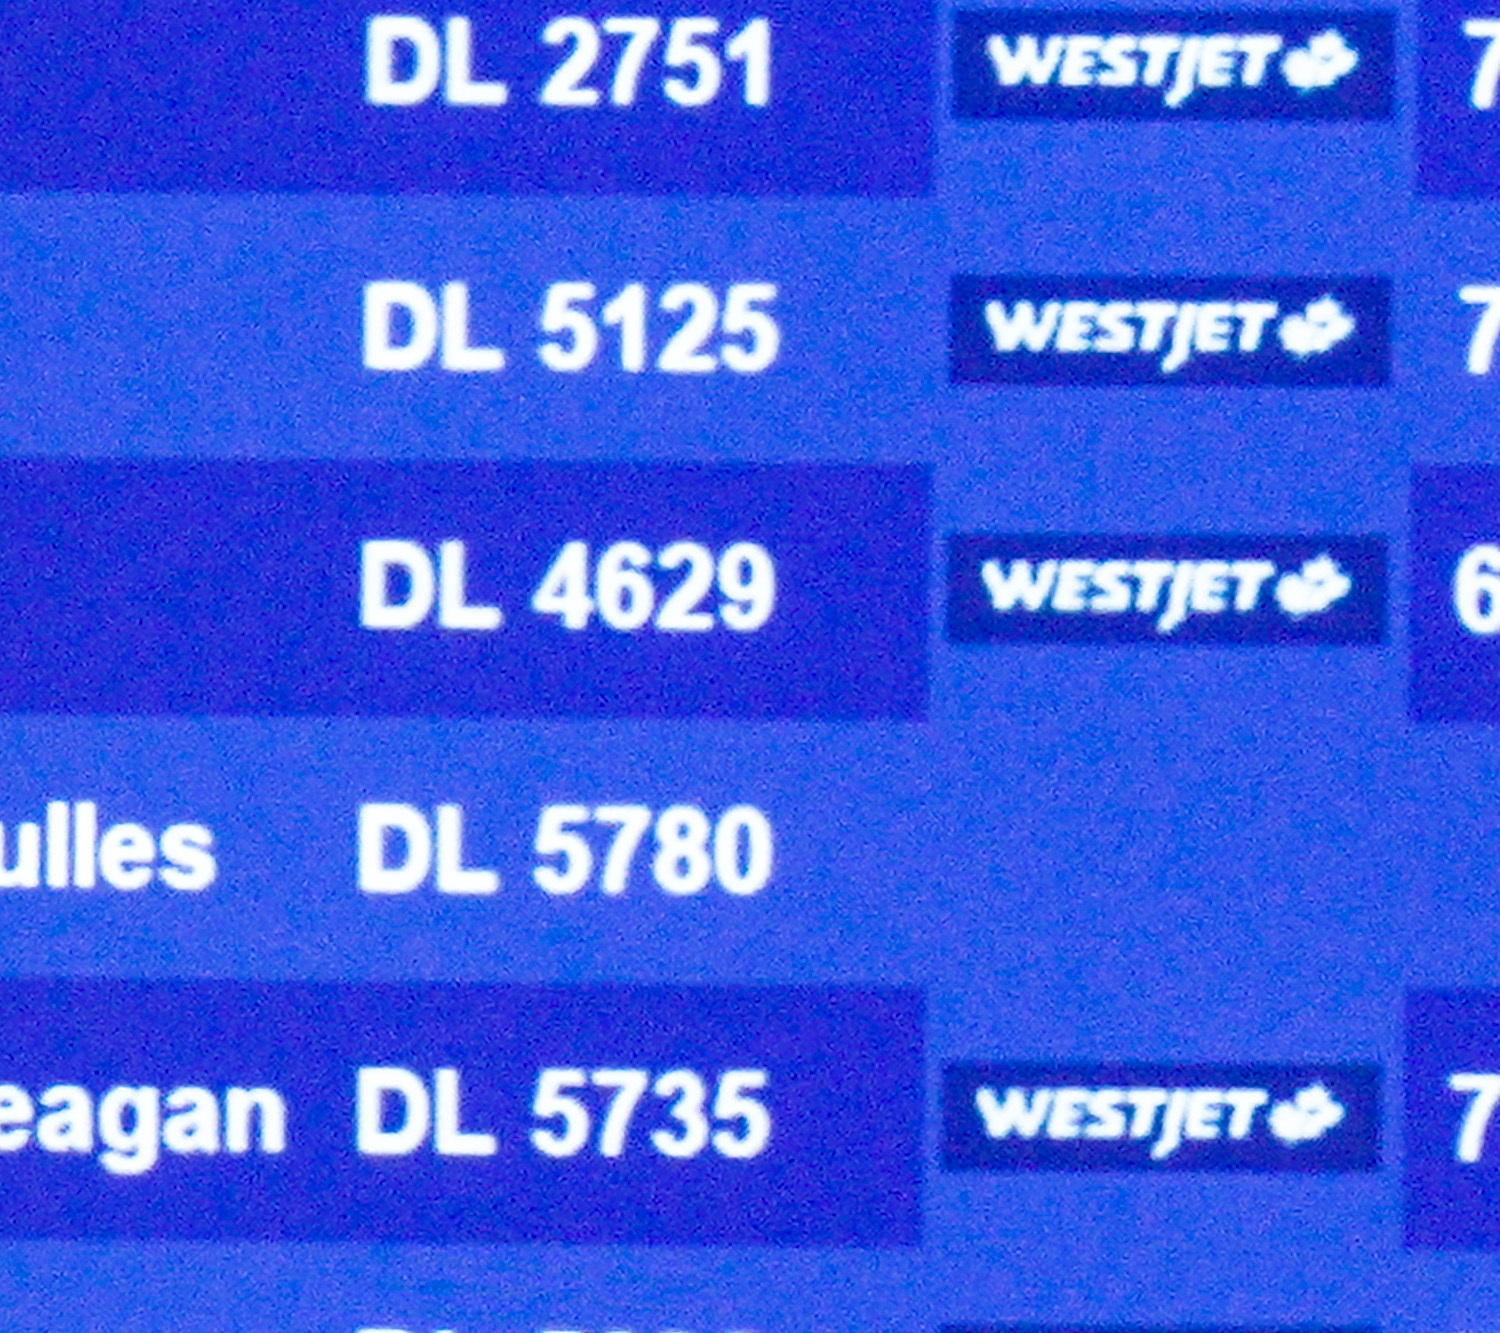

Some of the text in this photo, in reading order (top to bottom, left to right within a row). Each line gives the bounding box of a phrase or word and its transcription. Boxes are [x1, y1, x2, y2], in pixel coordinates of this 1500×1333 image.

[366, 13, 772, 108] DL 2751
[986, 32, 1284, 108] WESTJET
[362, 278, 782, 376] DL 5125
[985, 299, 1279, 373] WESTJET
[360, 538, 778, 633] DL 4629
[981, 558, 1276, 633] WESTJET
[356, 800, 776, 898] DL 5780
[356, 1065, 773, 1160] DL 5735
[975, 1086, 1269, 1160] WESTJET
